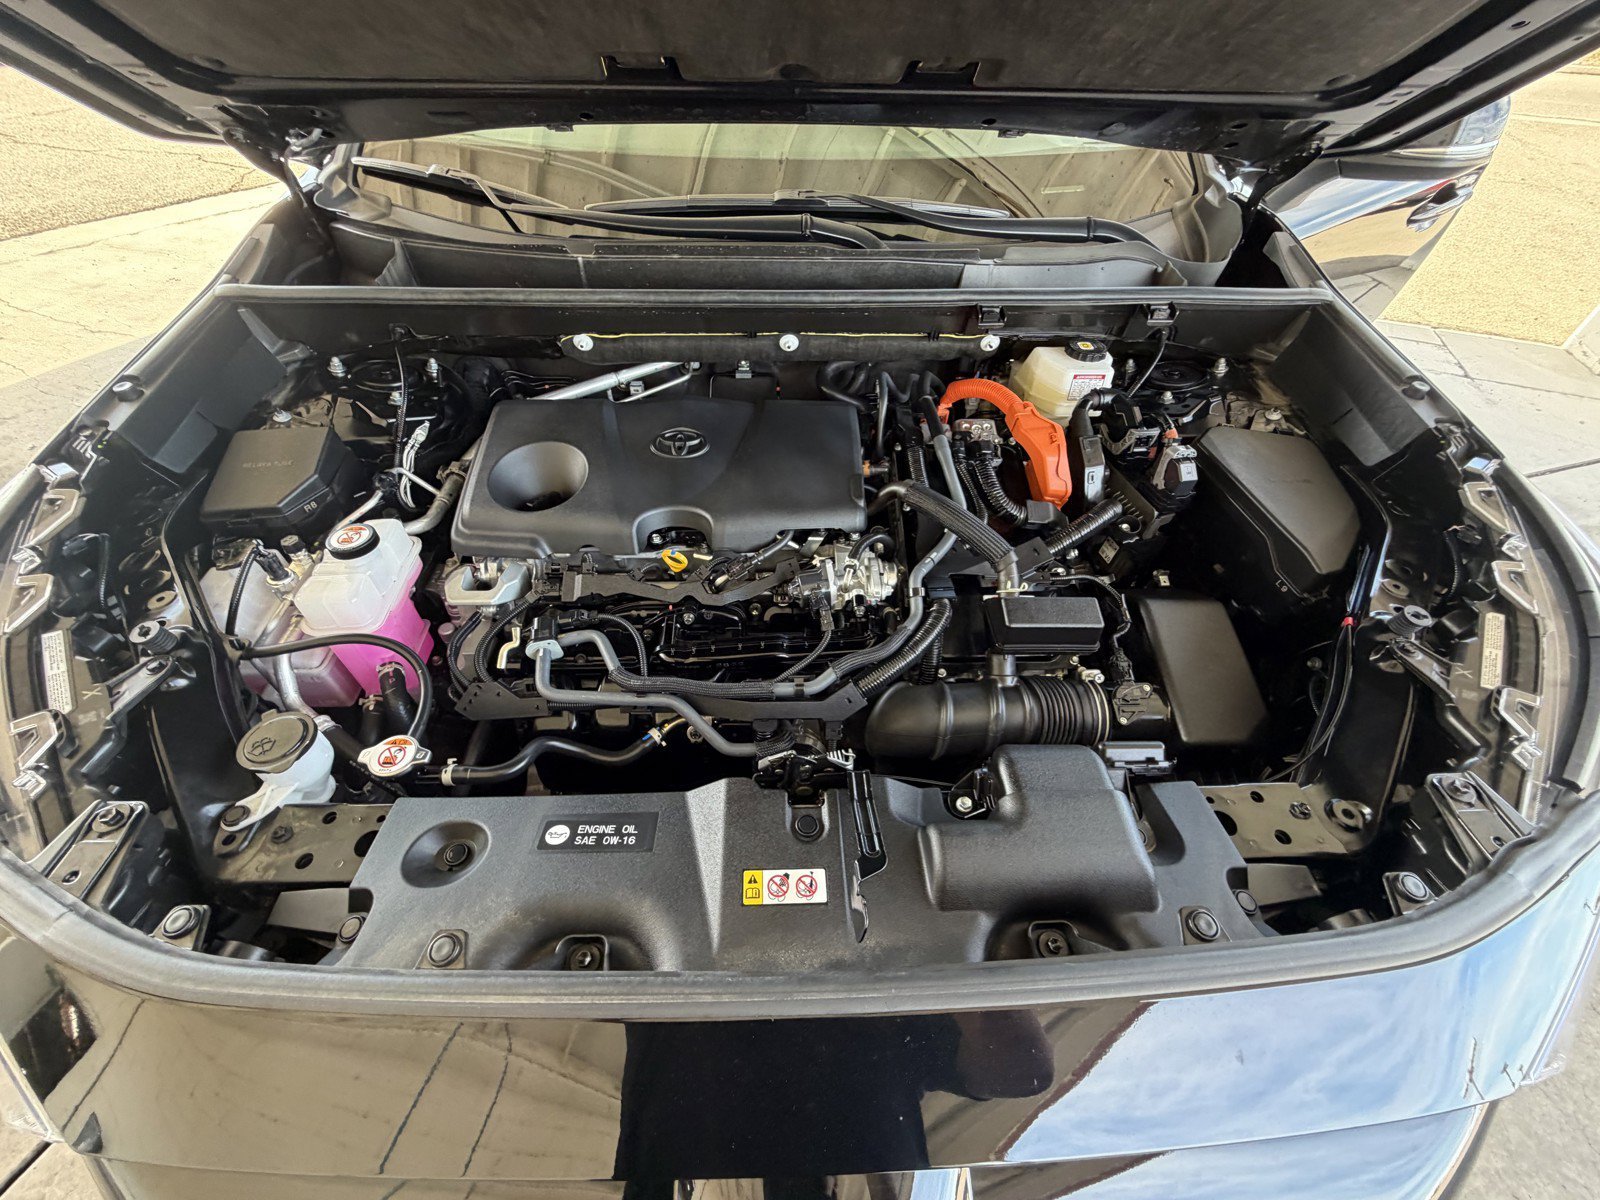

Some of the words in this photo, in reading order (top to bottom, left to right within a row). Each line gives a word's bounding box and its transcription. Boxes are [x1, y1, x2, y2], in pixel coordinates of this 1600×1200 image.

[577, 824, 616, 834] ENGINE
[621, 824, 638, 834] OIL
[574, 836, 597, 845] SAE
[602, 836, 636, 845] 0W-16
